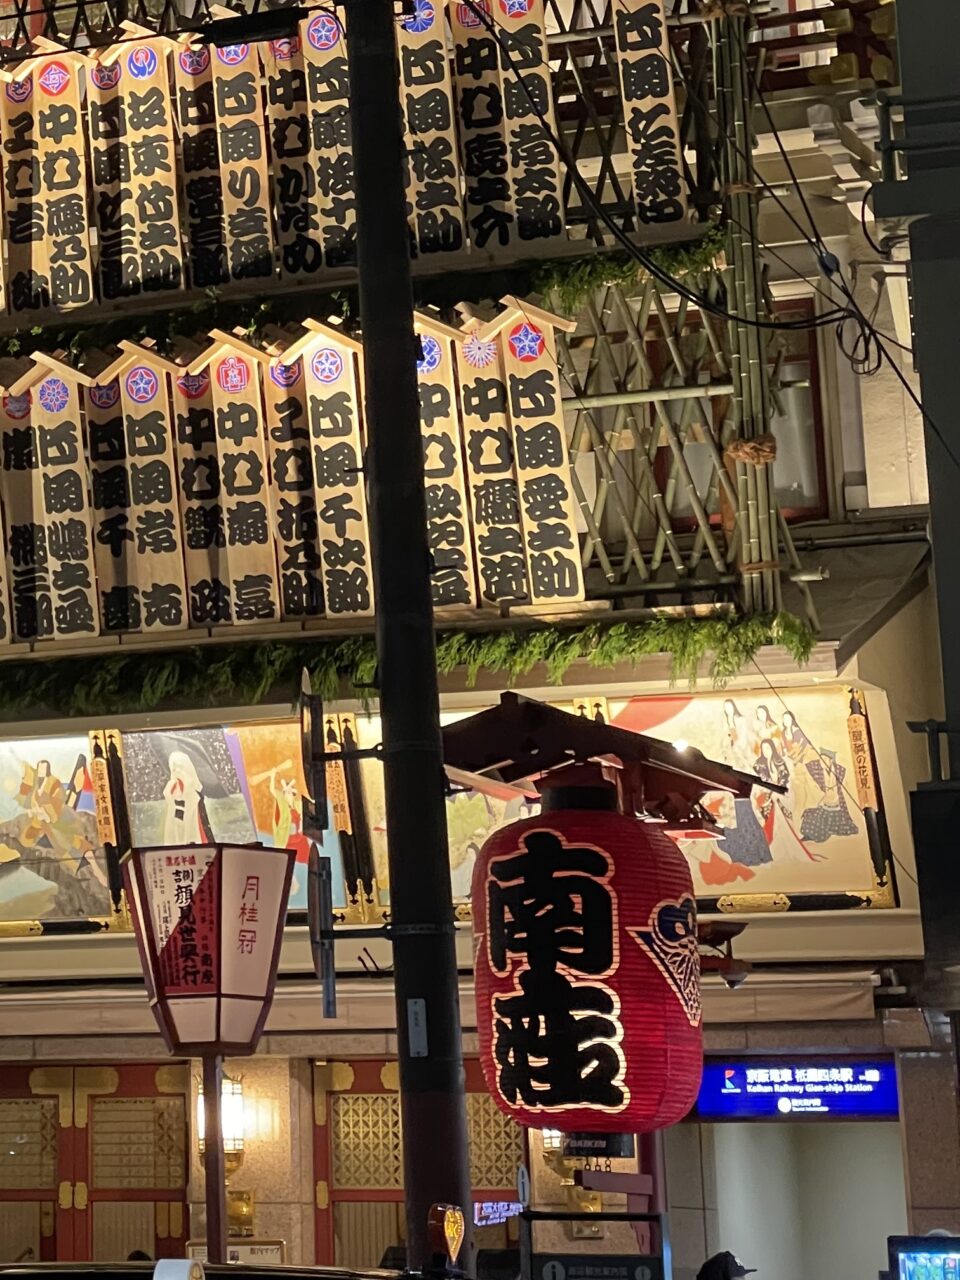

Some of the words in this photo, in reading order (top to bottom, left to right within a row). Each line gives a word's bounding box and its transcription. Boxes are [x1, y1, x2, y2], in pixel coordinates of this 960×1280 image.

[509, 368, 581, 599] 片岡愛之助
[238, 875, 260, 955] 月桂冠
[746, 1084, 773, 1093] Keihan
[774, 1084, 804, 1094] Railway
[845, 1083, 873, 1093] Station
